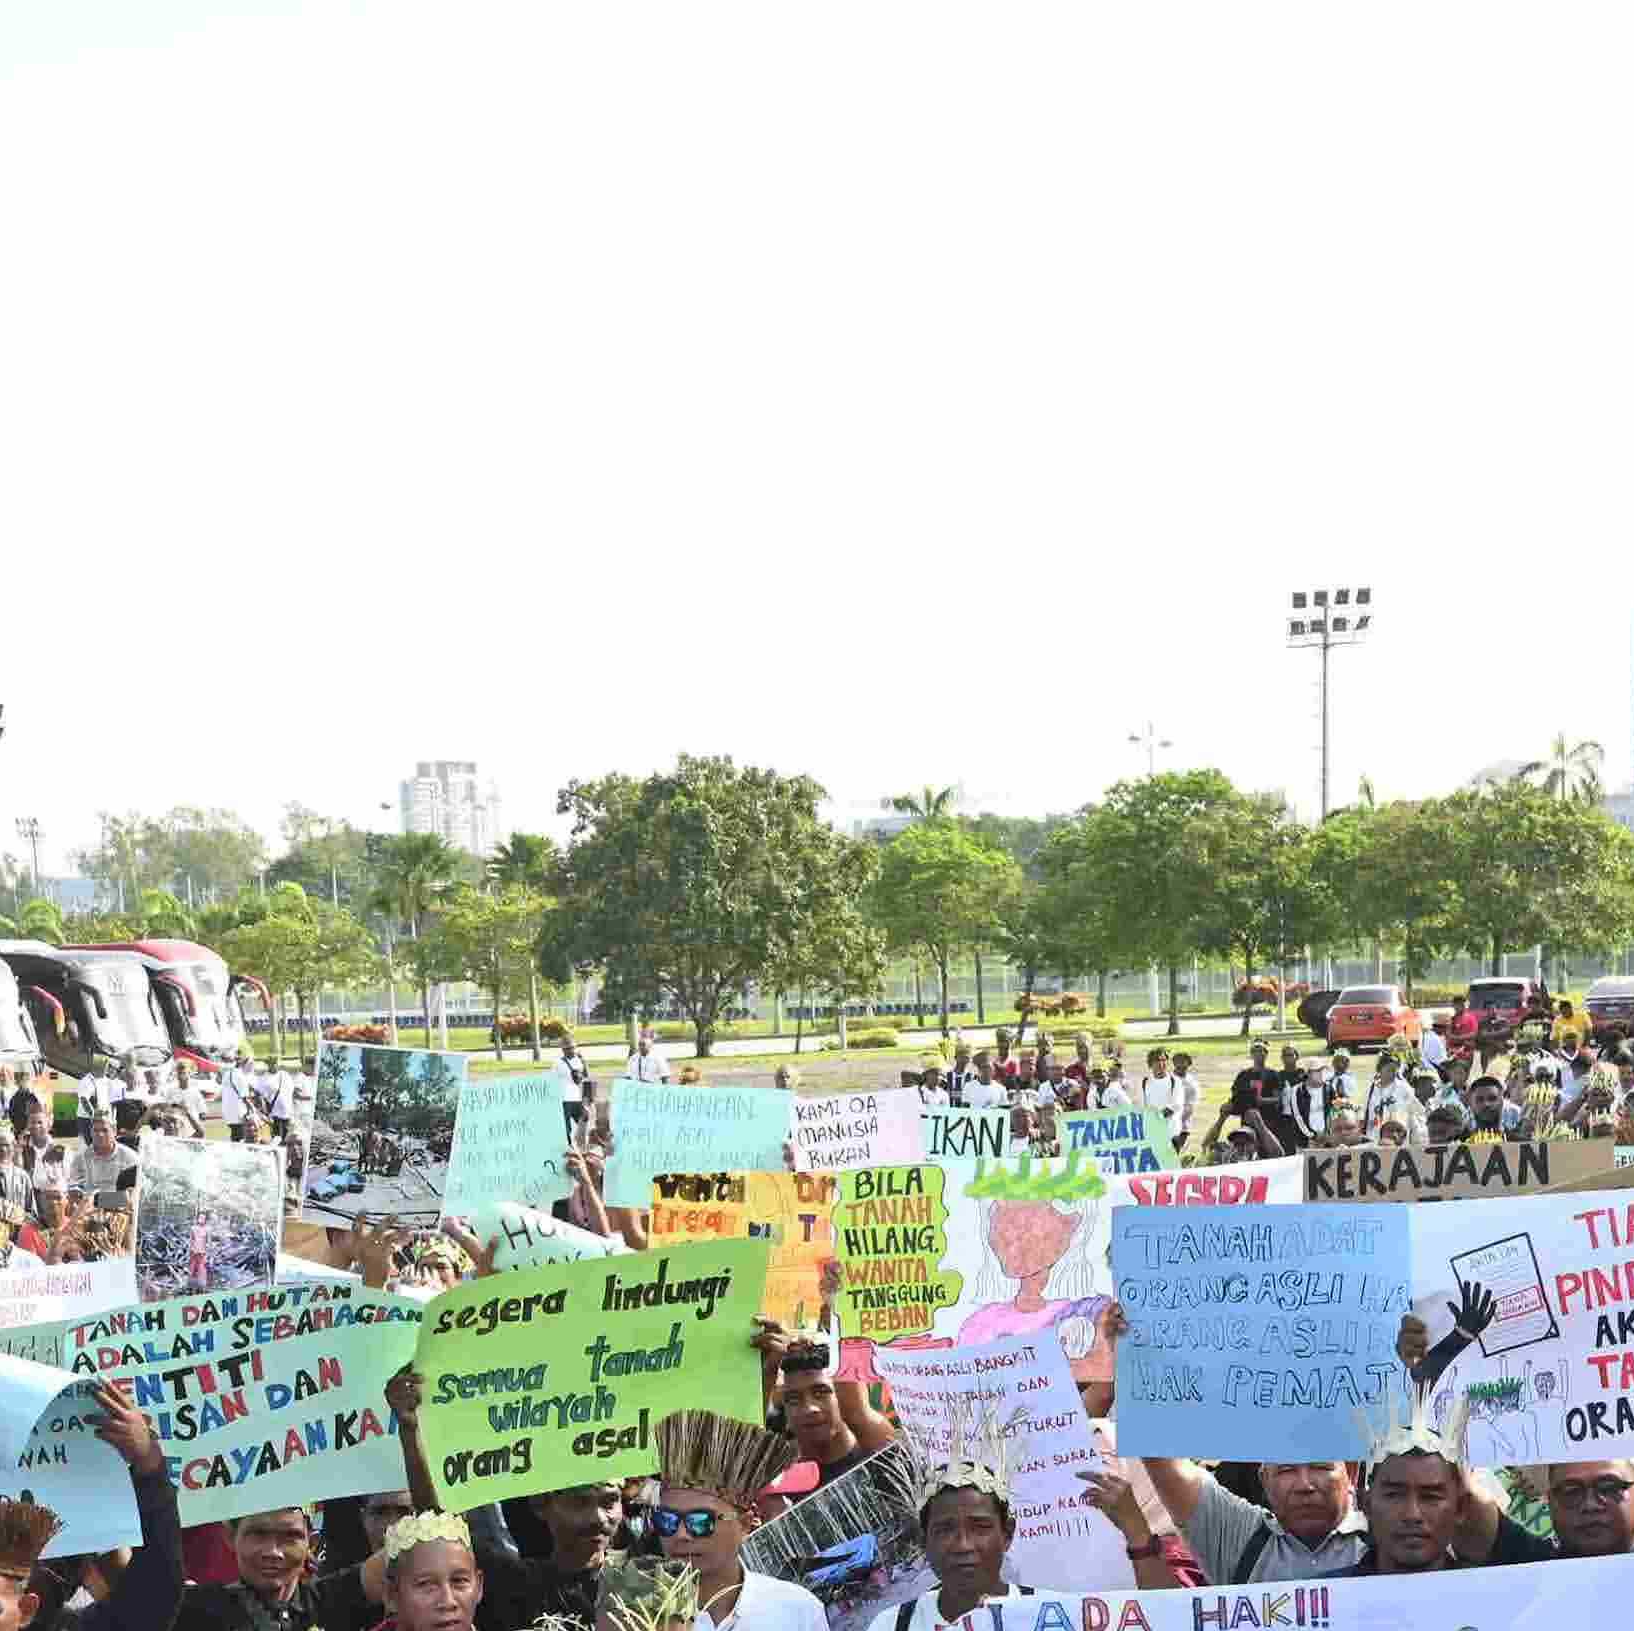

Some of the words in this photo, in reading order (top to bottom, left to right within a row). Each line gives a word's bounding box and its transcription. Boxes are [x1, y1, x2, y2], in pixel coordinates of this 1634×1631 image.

[795, 1099, 842, 1121] KAMI
[848, 1095, 878, 1114] OA
[807, 1143, 871, 1169] BUKAN
[1306, 1141, 1550, 1198] KERAJAAN
[854, 1168, 924, 1199] BILA
[845, 1195, 932, 1226] TANAH
[846, 1254, 927, 1284] WANITA
[1256, 1269, 1345, 1312] ASLI
[69, 1309, 165, 1349] TANAH
[181, 1297, 240, 1329] DAN
[245, 1284, 353, 1314] HUTAN
[433, 1286, 567, 1336] segera
[601, 1258, 733, 1320] lindungi
[847, 1283, 946, 1310] TANGGUNG
[71, 1328, 215, 1374] ADALAH
[230, 1304, 424, 1350] SEBAHAGIAN
[432, 1362, 548, 1404] semua
[584, 1322, 685, 1382] tanah
[265, 1356, 344, 1411] DAN
[443, 1437, 534, 1486] orang
[571, 1408, 651, 1459] asal
